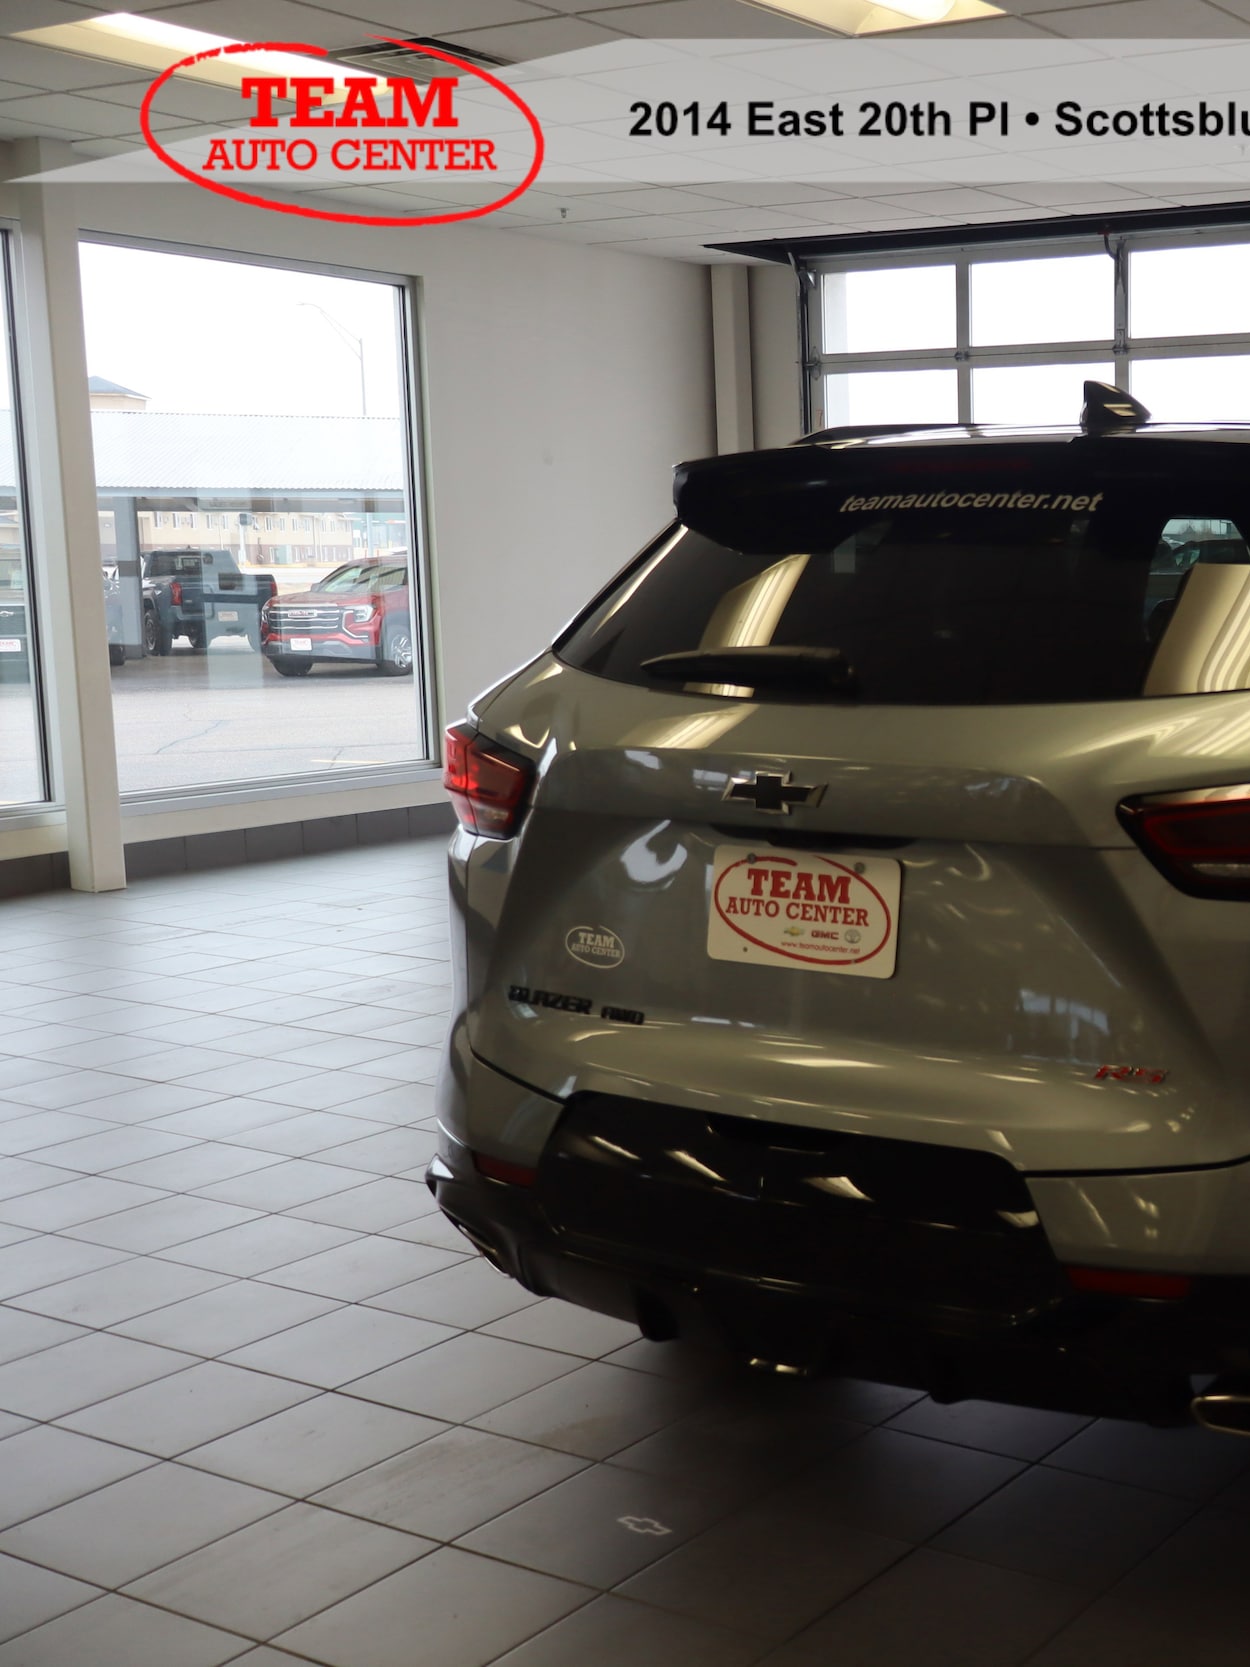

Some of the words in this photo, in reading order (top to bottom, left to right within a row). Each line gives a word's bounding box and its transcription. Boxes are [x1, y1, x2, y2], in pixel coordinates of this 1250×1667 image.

[839, 489, 1104, 513] teamautocenter.net
[747, 867, 852, 905] TEAM
[725, 896, 780, 919] AUTO
[785, 901, 870, 928] CENTER
[578, 931, 615, 949] TEAM
[811, 929, 839, 941] GMC
[571, 943, 591, 954] AUTO
[591, 946, 621, 959] CENTER
